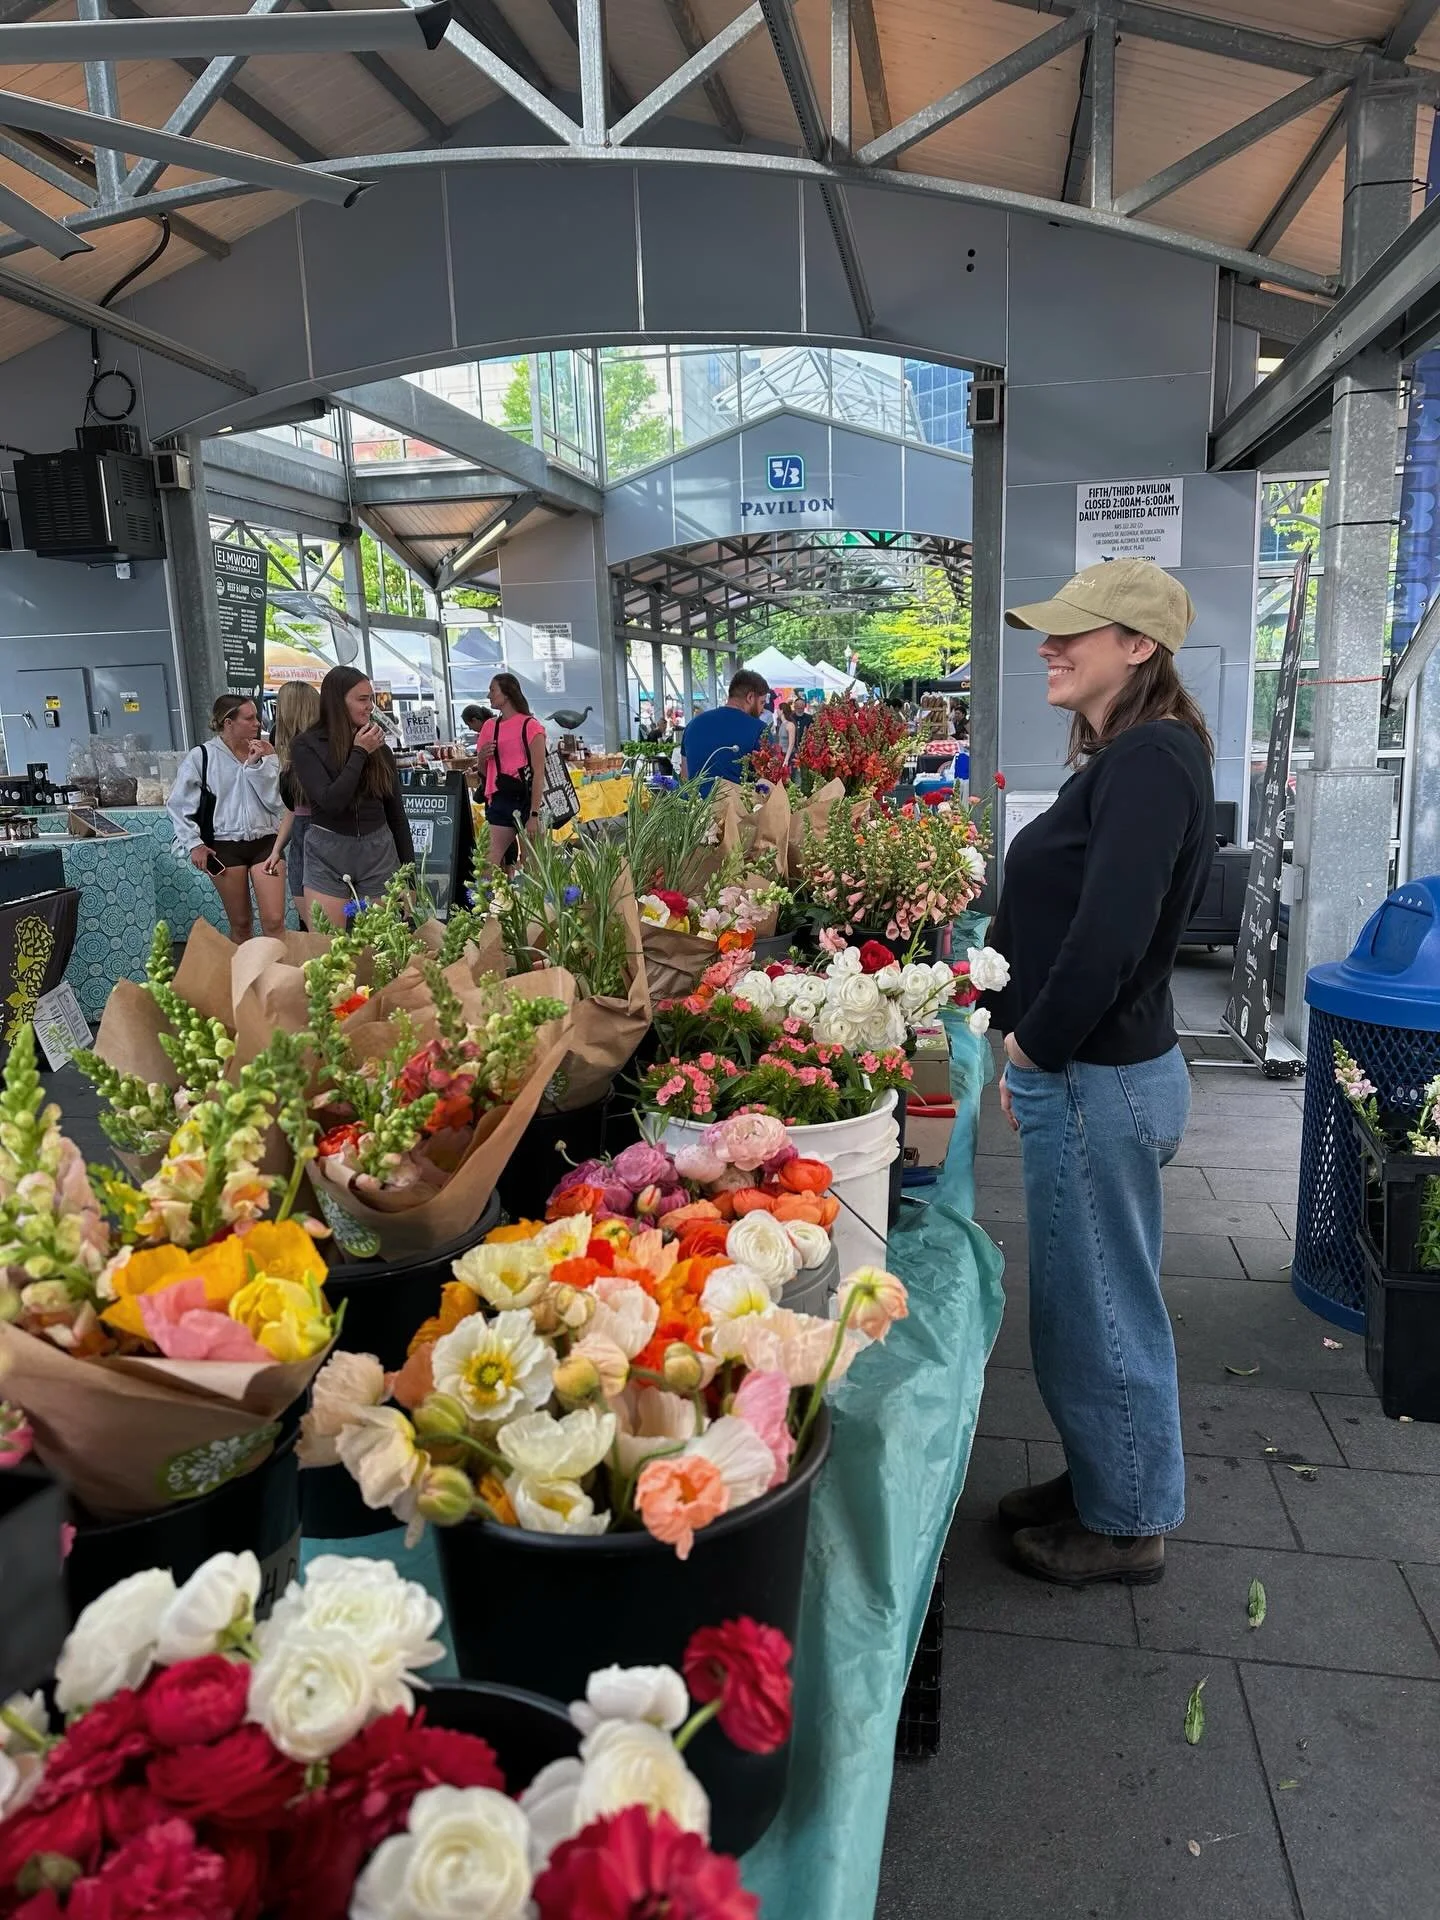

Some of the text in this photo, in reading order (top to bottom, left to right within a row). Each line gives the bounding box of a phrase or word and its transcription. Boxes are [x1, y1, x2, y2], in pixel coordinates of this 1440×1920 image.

[1088, 483, 1171, 498] FIFTH/THIRD PAVILION
[740, 498, 834, 517] PAVILION
[1084, 494, 1175, 510] CLOSED 2:00AM-6:00AM
[1079, 505, 1180, 521] DAILY PROHIBITED ACTIVITY
[216, 550, 258, 569] ELMWOOD
[225, 564, 239, 572] STOCK
[406, 716, 429, 726] FREE
[404, 798, 445, 809] MWOOD
